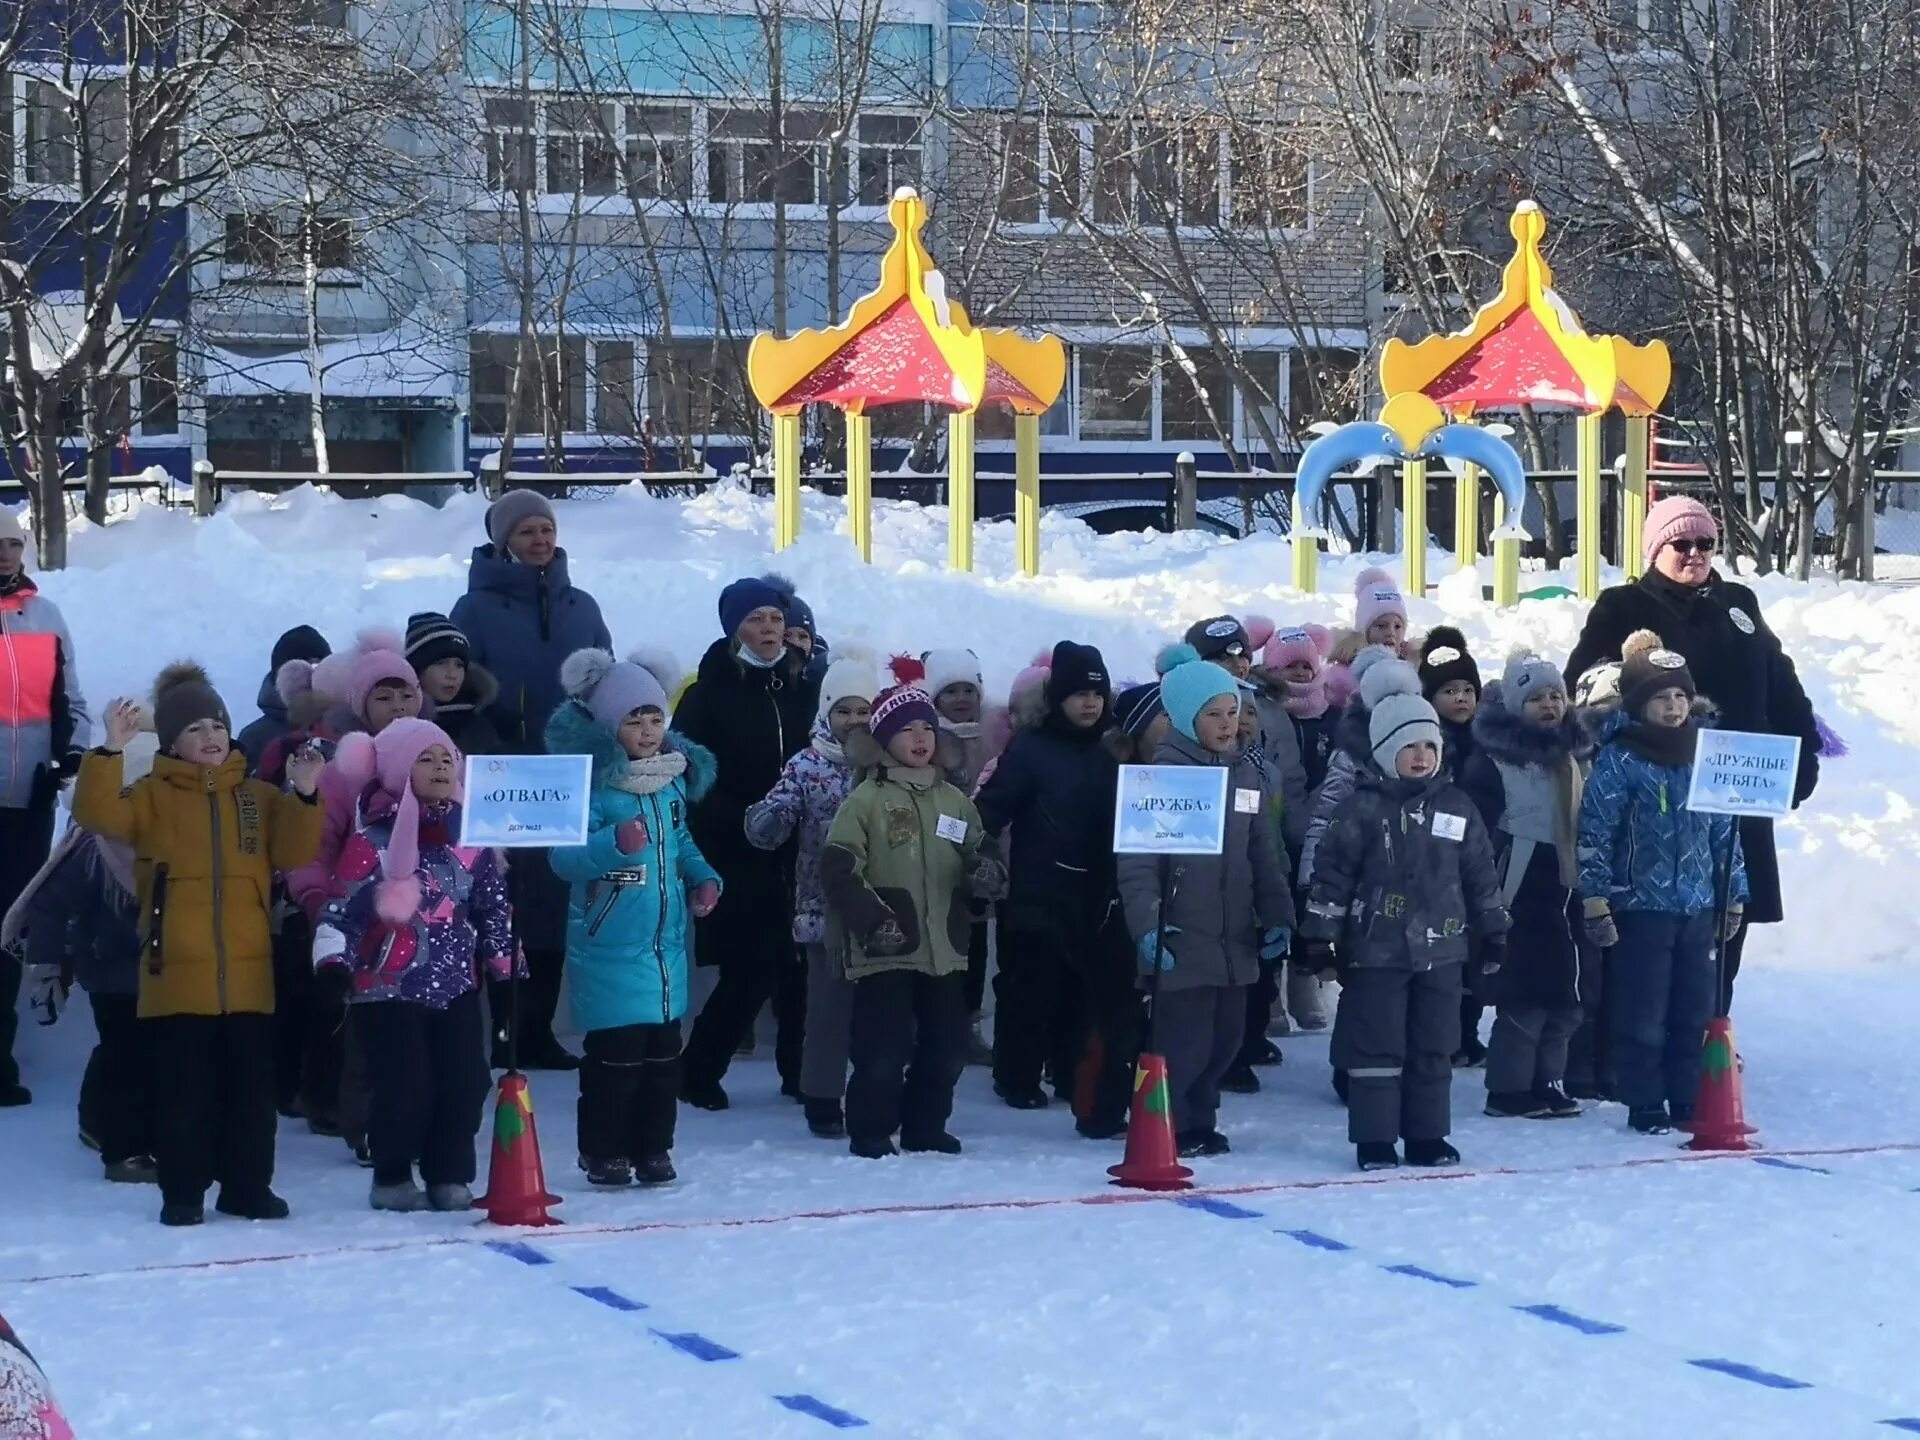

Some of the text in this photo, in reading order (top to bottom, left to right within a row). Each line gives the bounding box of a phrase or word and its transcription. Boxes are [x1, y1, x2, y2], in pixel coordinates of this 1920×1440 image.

[1704, 753, 1789, 771] «ДРУЖНЫЕ
[1713, 772, 1776, 788] РЕБЯТА»
[484, 788, 571, 802] «ОТВАГА»
[1131, 798, 1211, 812] «ДРУЖБА»
[507, 824, 524, 832] ДОУ
